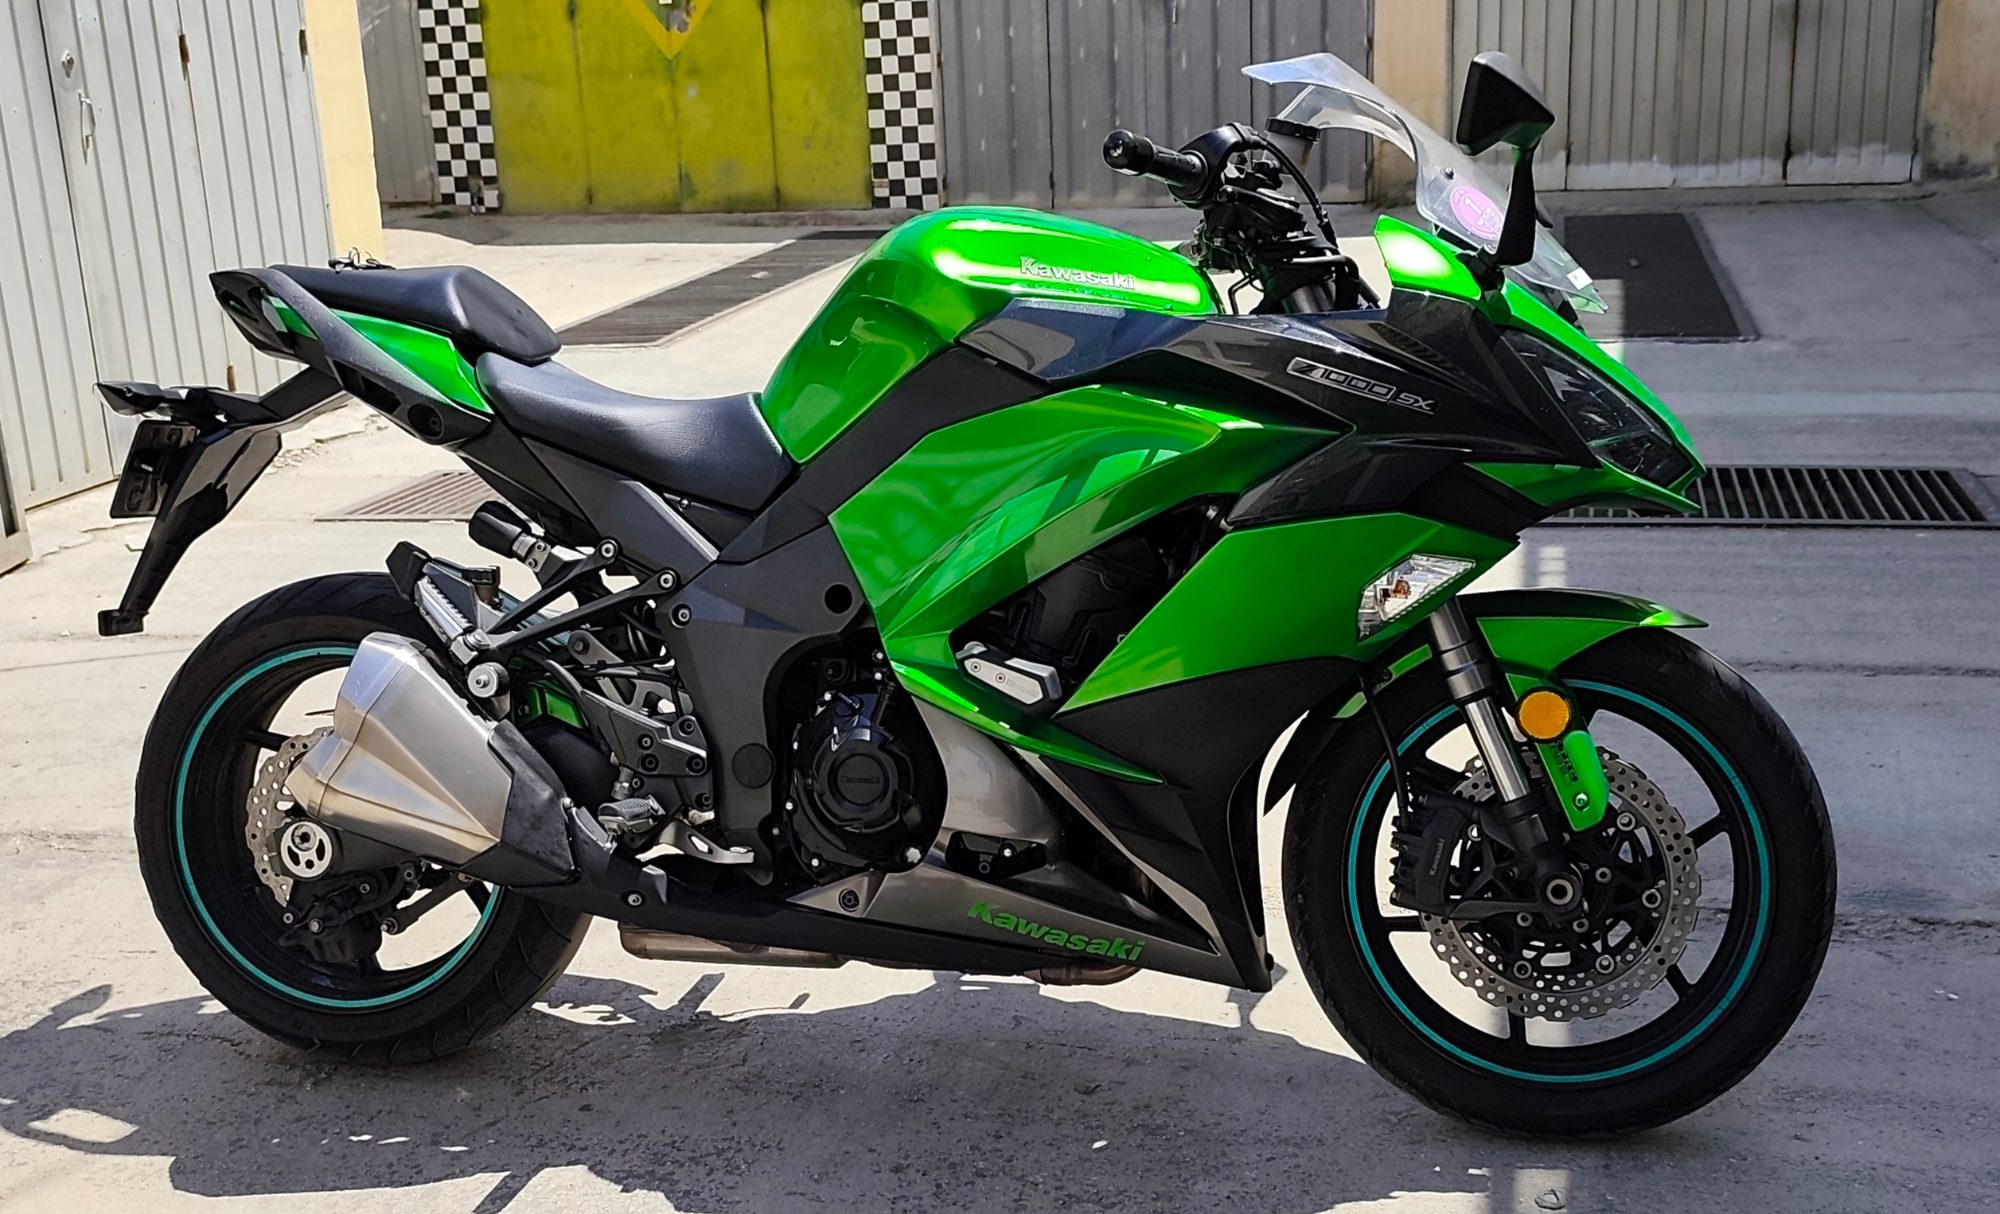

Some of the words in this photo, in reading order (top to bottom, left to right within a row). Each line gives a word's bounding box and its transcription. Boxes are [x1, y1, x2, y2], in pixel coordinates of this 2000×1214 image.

[1020, 256, 1135, 289] Kawasaki
[1397, 392, 1435, 411] SX
[967, 900, 1146, 961] Kawasaki
